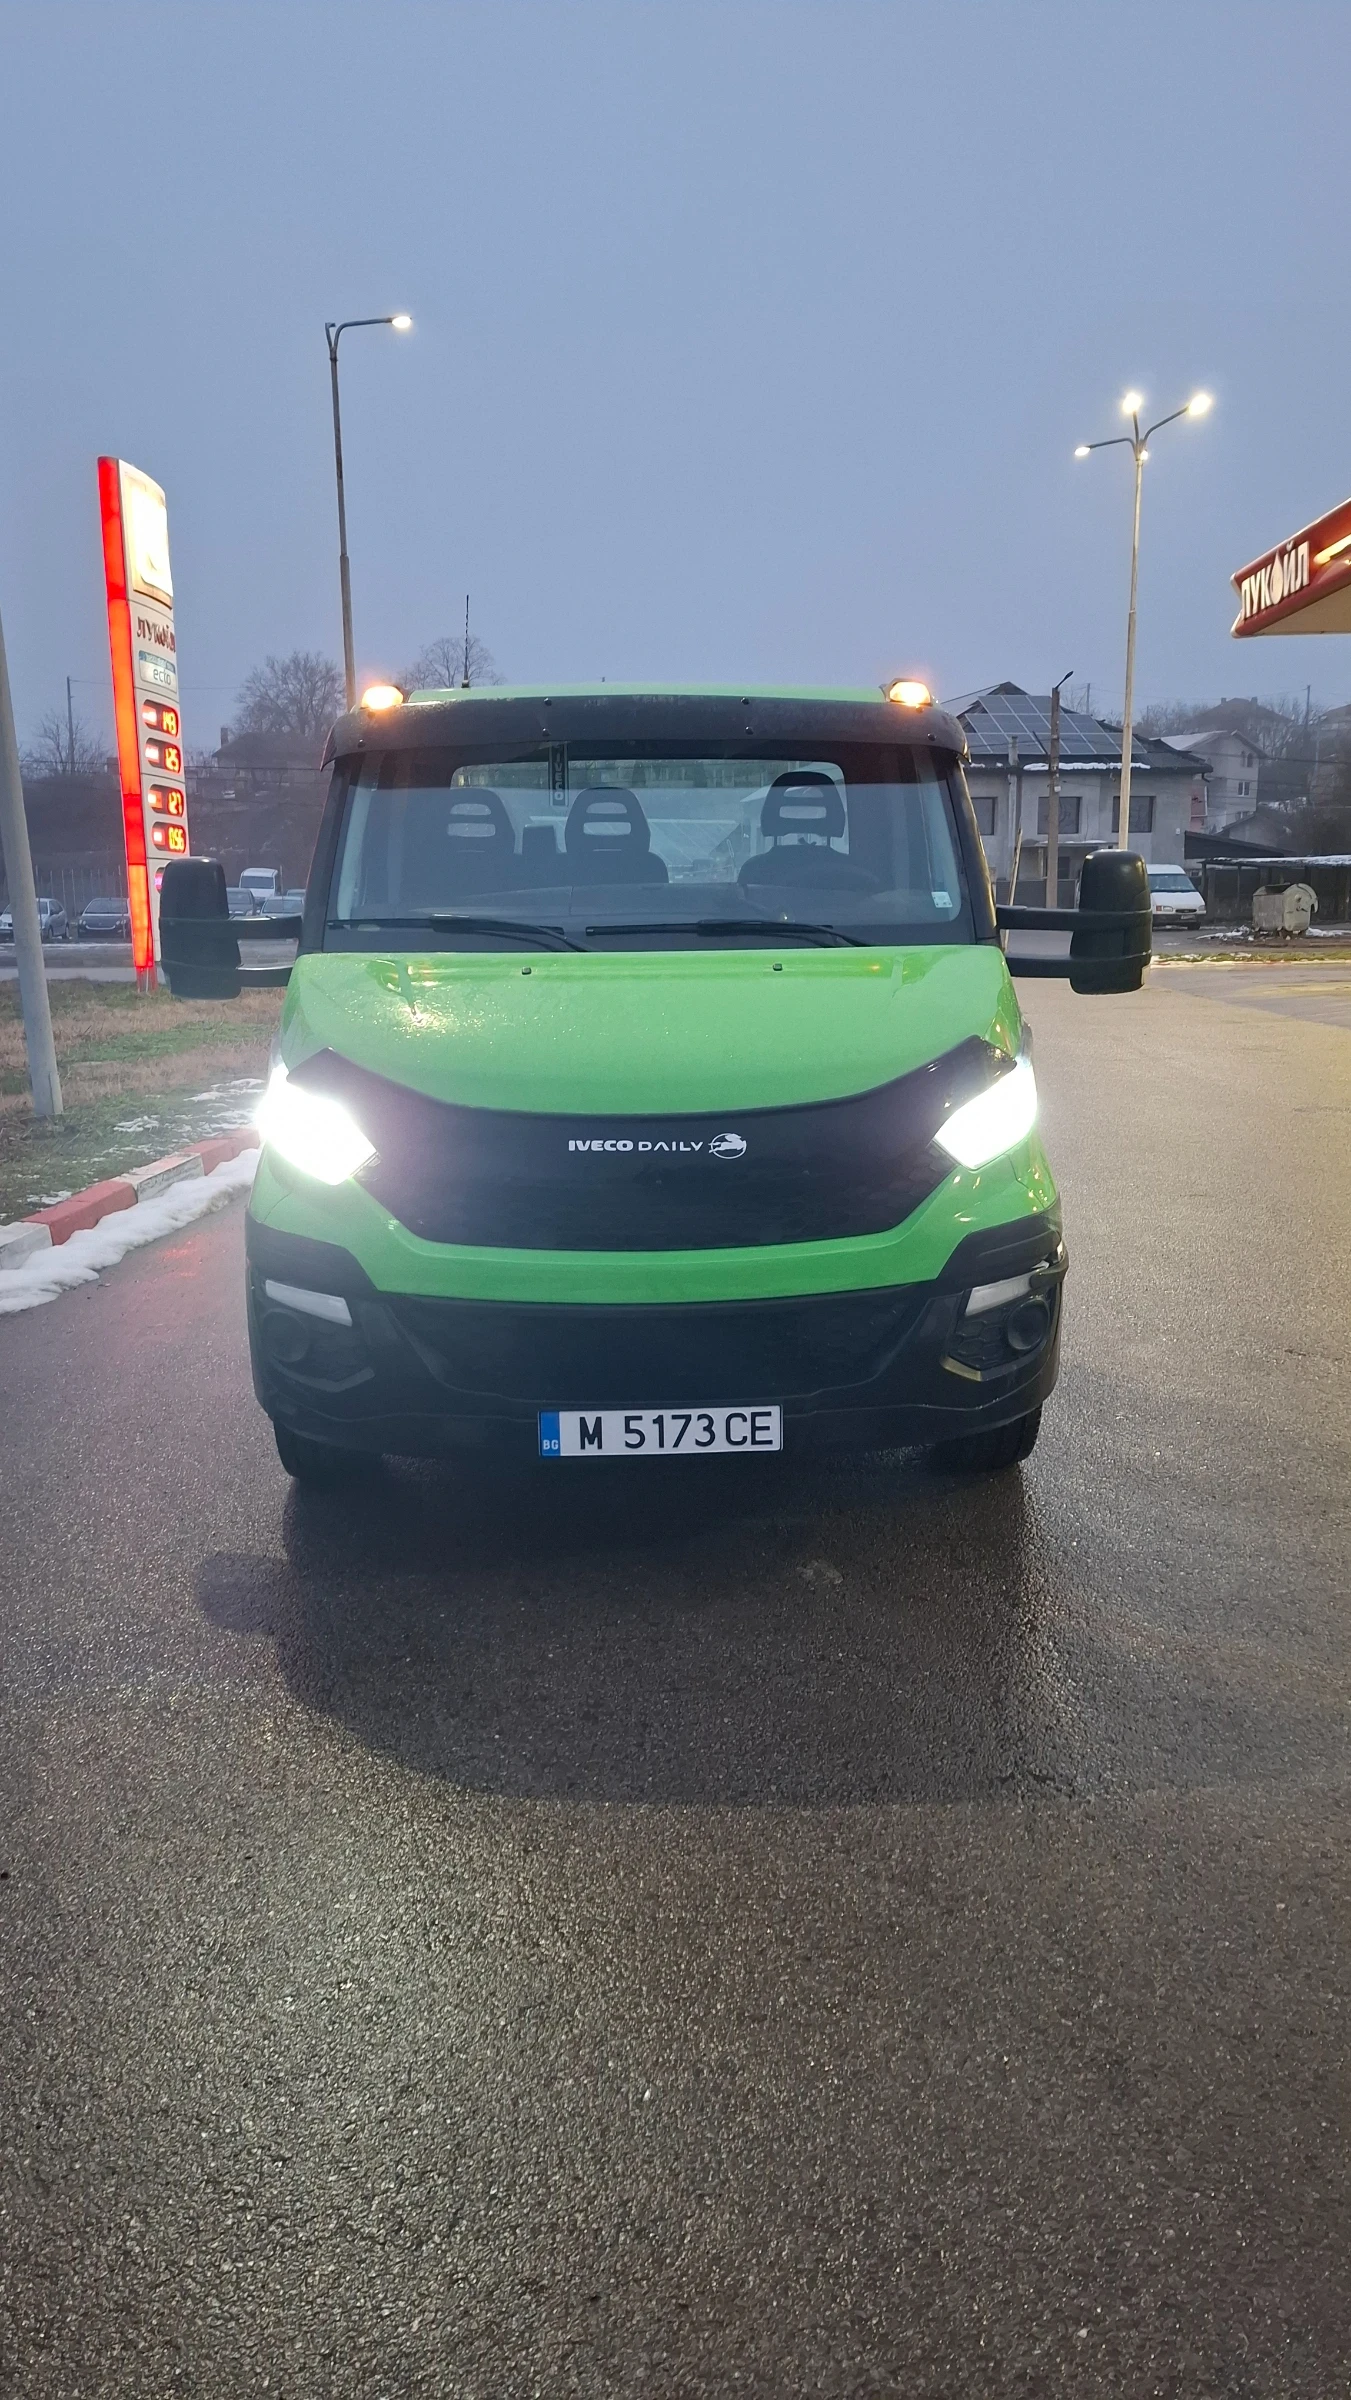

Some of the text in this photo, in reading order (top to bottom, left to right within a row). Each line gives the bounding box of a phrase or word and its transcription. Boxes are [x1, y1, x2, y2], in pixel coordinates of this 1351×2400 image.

[568, 1140, 703, 1152] IVECO DAILY
[543, 1439, 559, 1450] BG
